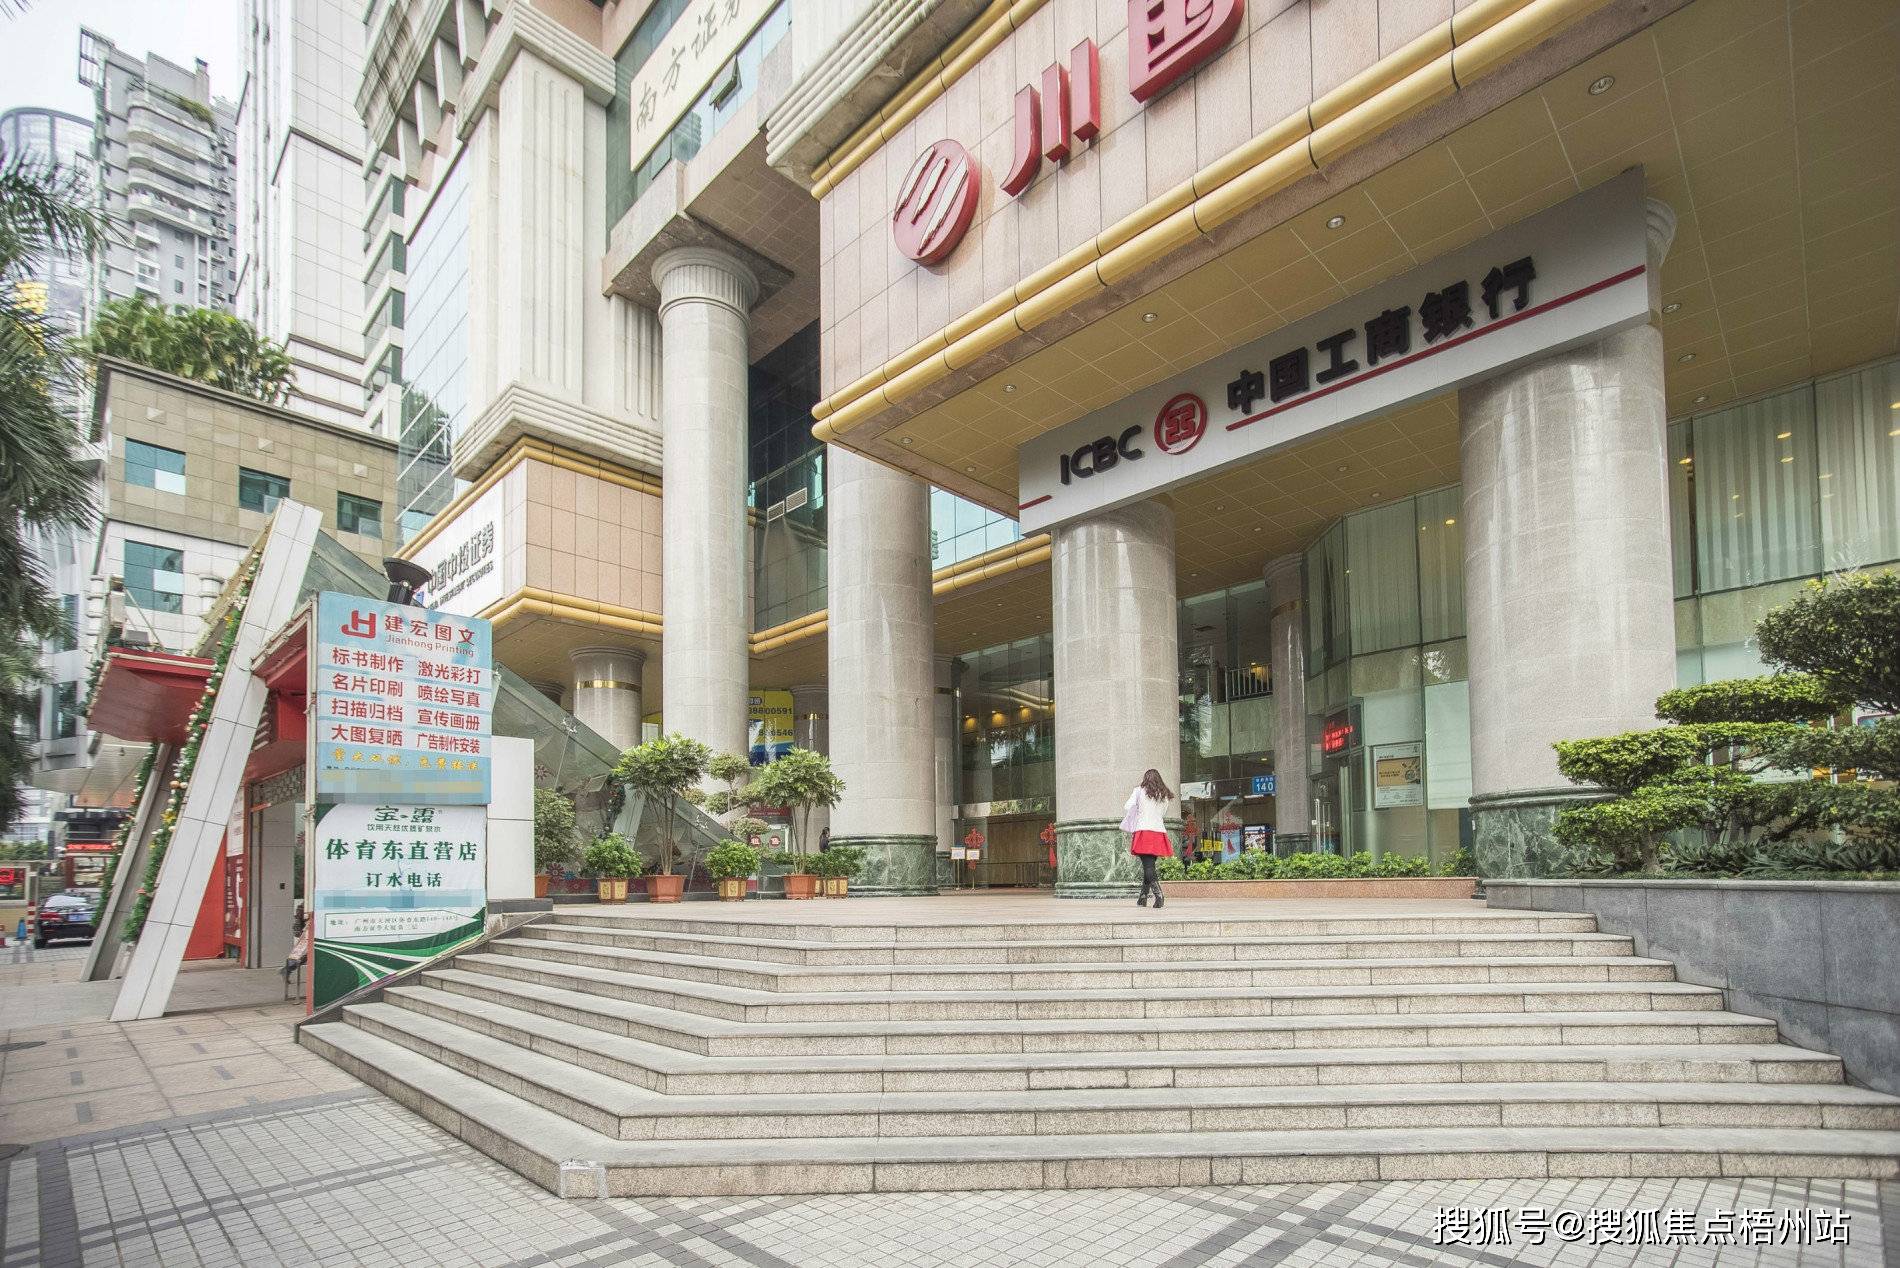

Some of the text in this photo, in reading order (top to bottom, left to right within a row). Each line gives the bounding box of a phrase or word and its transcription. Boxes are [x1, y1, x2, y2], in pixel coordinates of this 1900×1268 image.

[1059, 424, 1145, 486] ICBC
[384, 614, 475, 646] 建宏图文
[386, 634, 474, 658] Jianhong Printing
[332, 647, 481, 685] 标书制作 激光彩打
[332, 673, 480, 708] 名片印刷 喷绘写真
[331, 698, 480, 731] 扫描归档 宣传画册
[331, 724, 480, 754] 大图复晒 广告制作安装
[1256, 781, 1274, 792] 140
[367, 823, 441, 833] 饮用天然优质矿泉水
[325, 838, 477, 861] 体育东直营店
[365, 872, 442, 888] 订水电话
